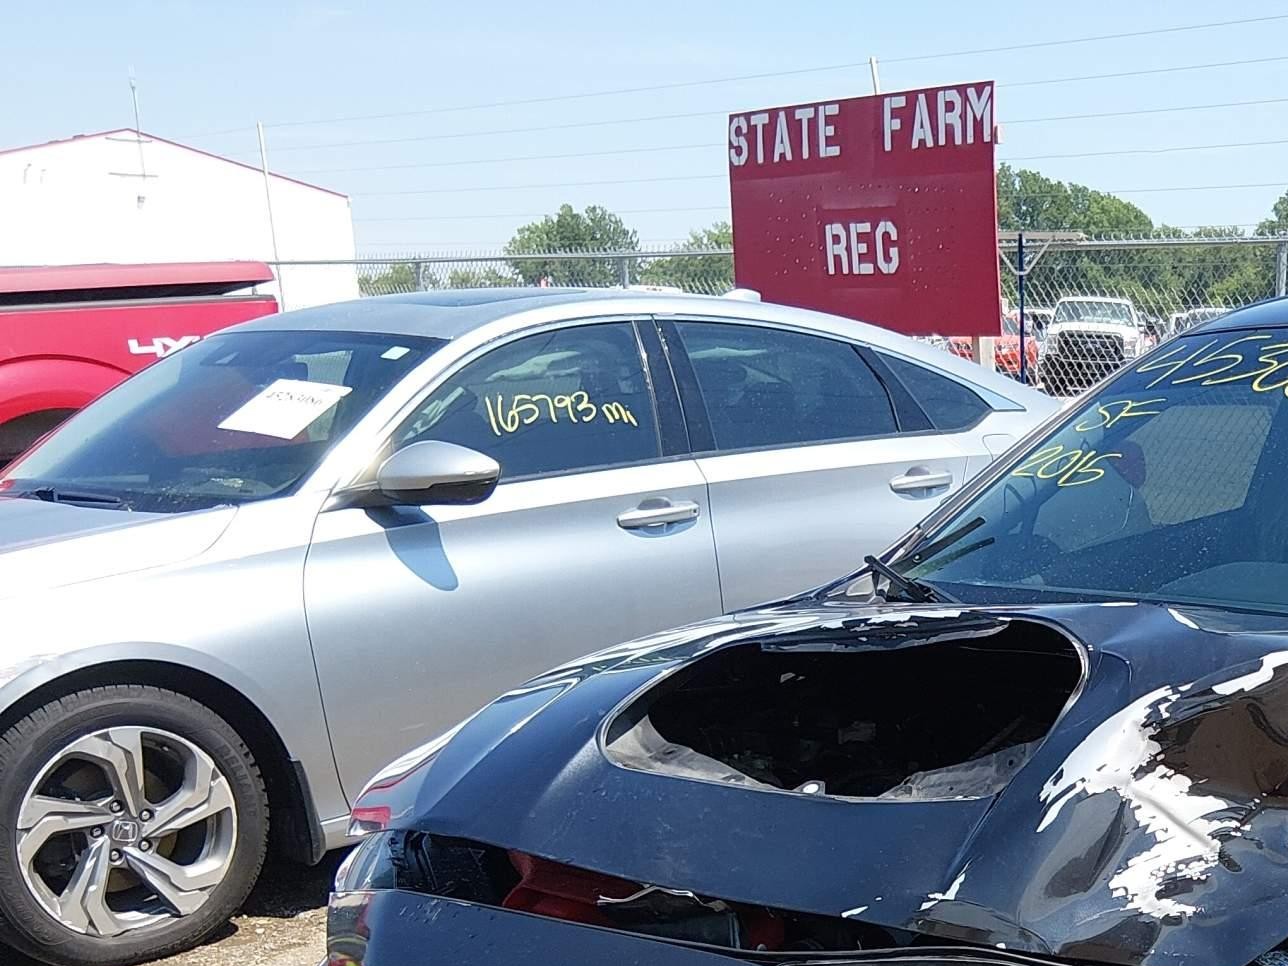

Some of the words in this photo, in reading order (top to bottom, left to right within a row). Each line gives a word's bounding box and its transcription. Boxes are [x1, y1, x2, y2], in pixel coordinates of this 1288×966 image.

[729, 104, 841, 166] STATE
[882, 86, 991, 151] FARM
[825, 221, 899, 275] REG
[485, 391, 598, 436] 165793
[1075, 398, 1168, 432] SF
[1011, 445, 1123, 487] 2015
